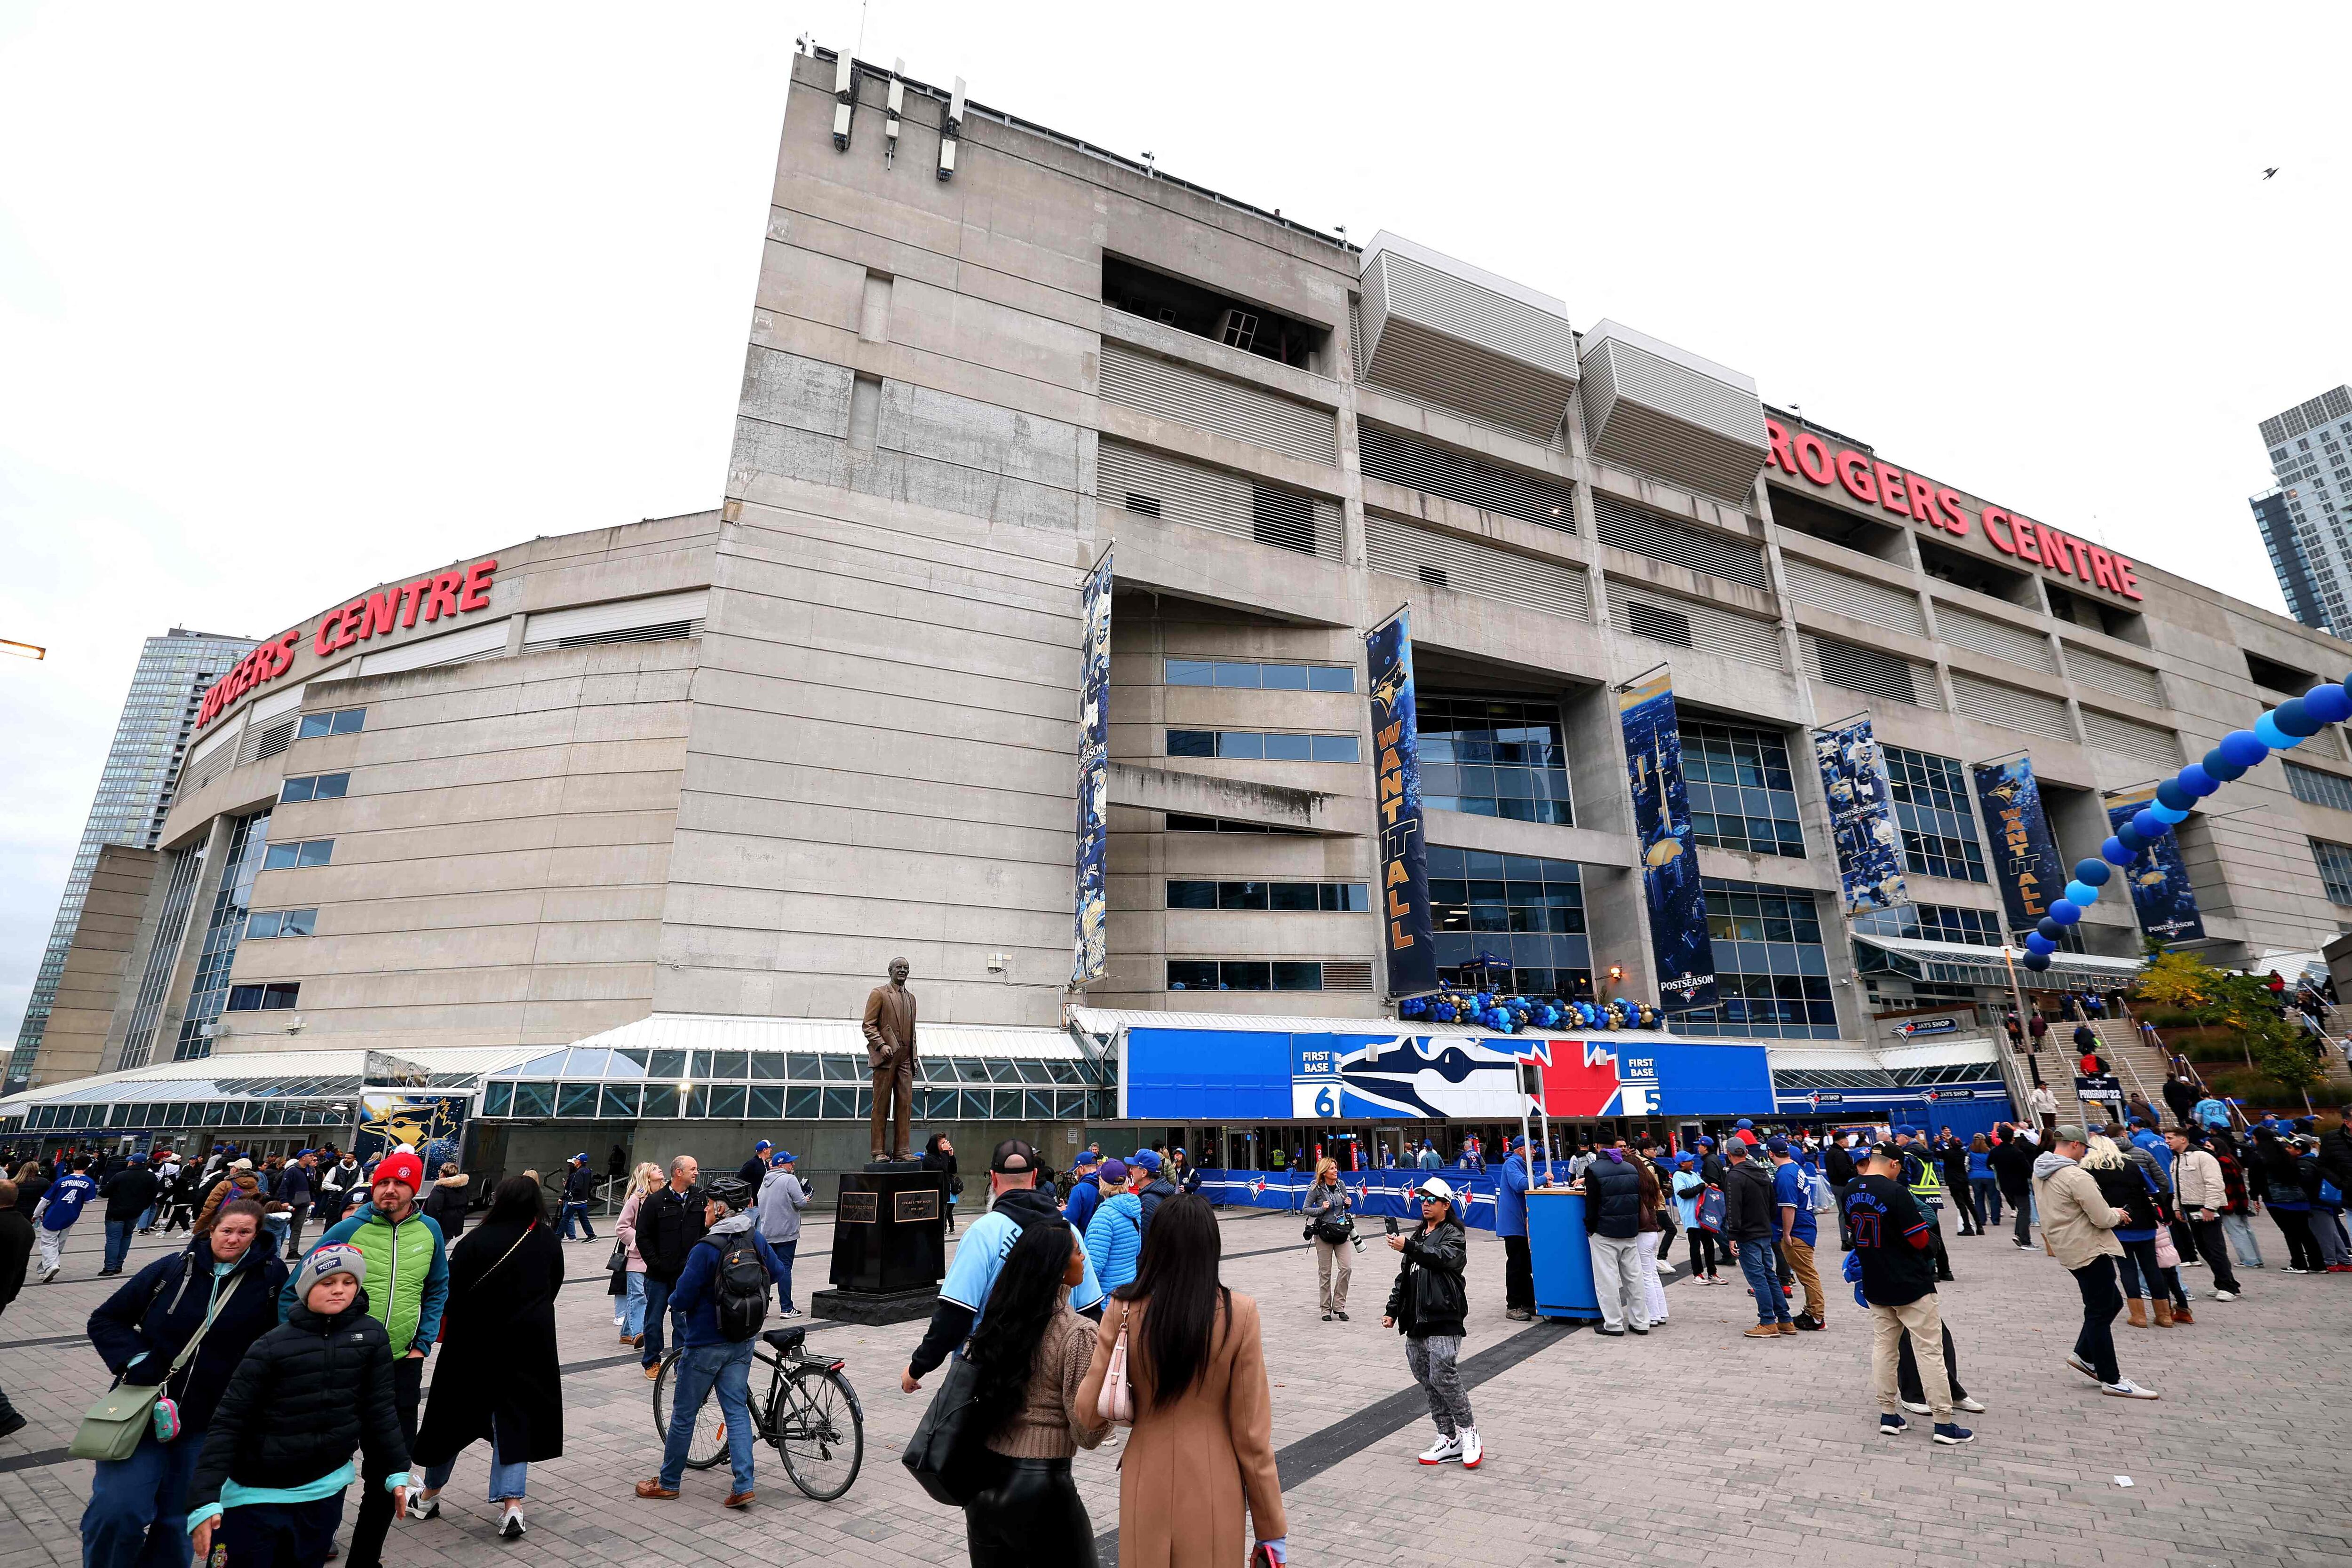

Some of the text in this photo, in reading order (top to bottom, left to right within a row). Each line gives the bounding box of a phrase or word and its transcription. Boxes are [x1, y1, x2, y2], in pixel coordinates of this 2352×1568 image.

[1765, 417, 2143, 602] ROGERS CENTRE
[196, 559, 497, 729] ROGERS CENTRE
[1836, 802, 1878, 820] POSTSEASON
[1377, 720, 1417, 950] WANT IT ALL
[1999, 807, 2045, 915] WANT IT ALL
[2147, 921, 2195, 932] POSTSEASON
[1661, 974, 1714, 991] POSTSEASON
[1303, 1051, 1330, 1061] FIRST
[1629, 1058, 1653, 1067] FIRST
[1304, 1062, 1329, 1073] BASE
[1630, 1068, 1654, 1077] BASE
[1315, 1086, 1334, 1117] 6
[1645, 1089, 1661, 1115] 5
[2079, 1089, 2108, 1099] PROGRAM
[61, 1180, 89, 1189] SPRINGER
[61, 1189, 78, 1204] 4
[1851, 1212, 1880, 1247] 27
